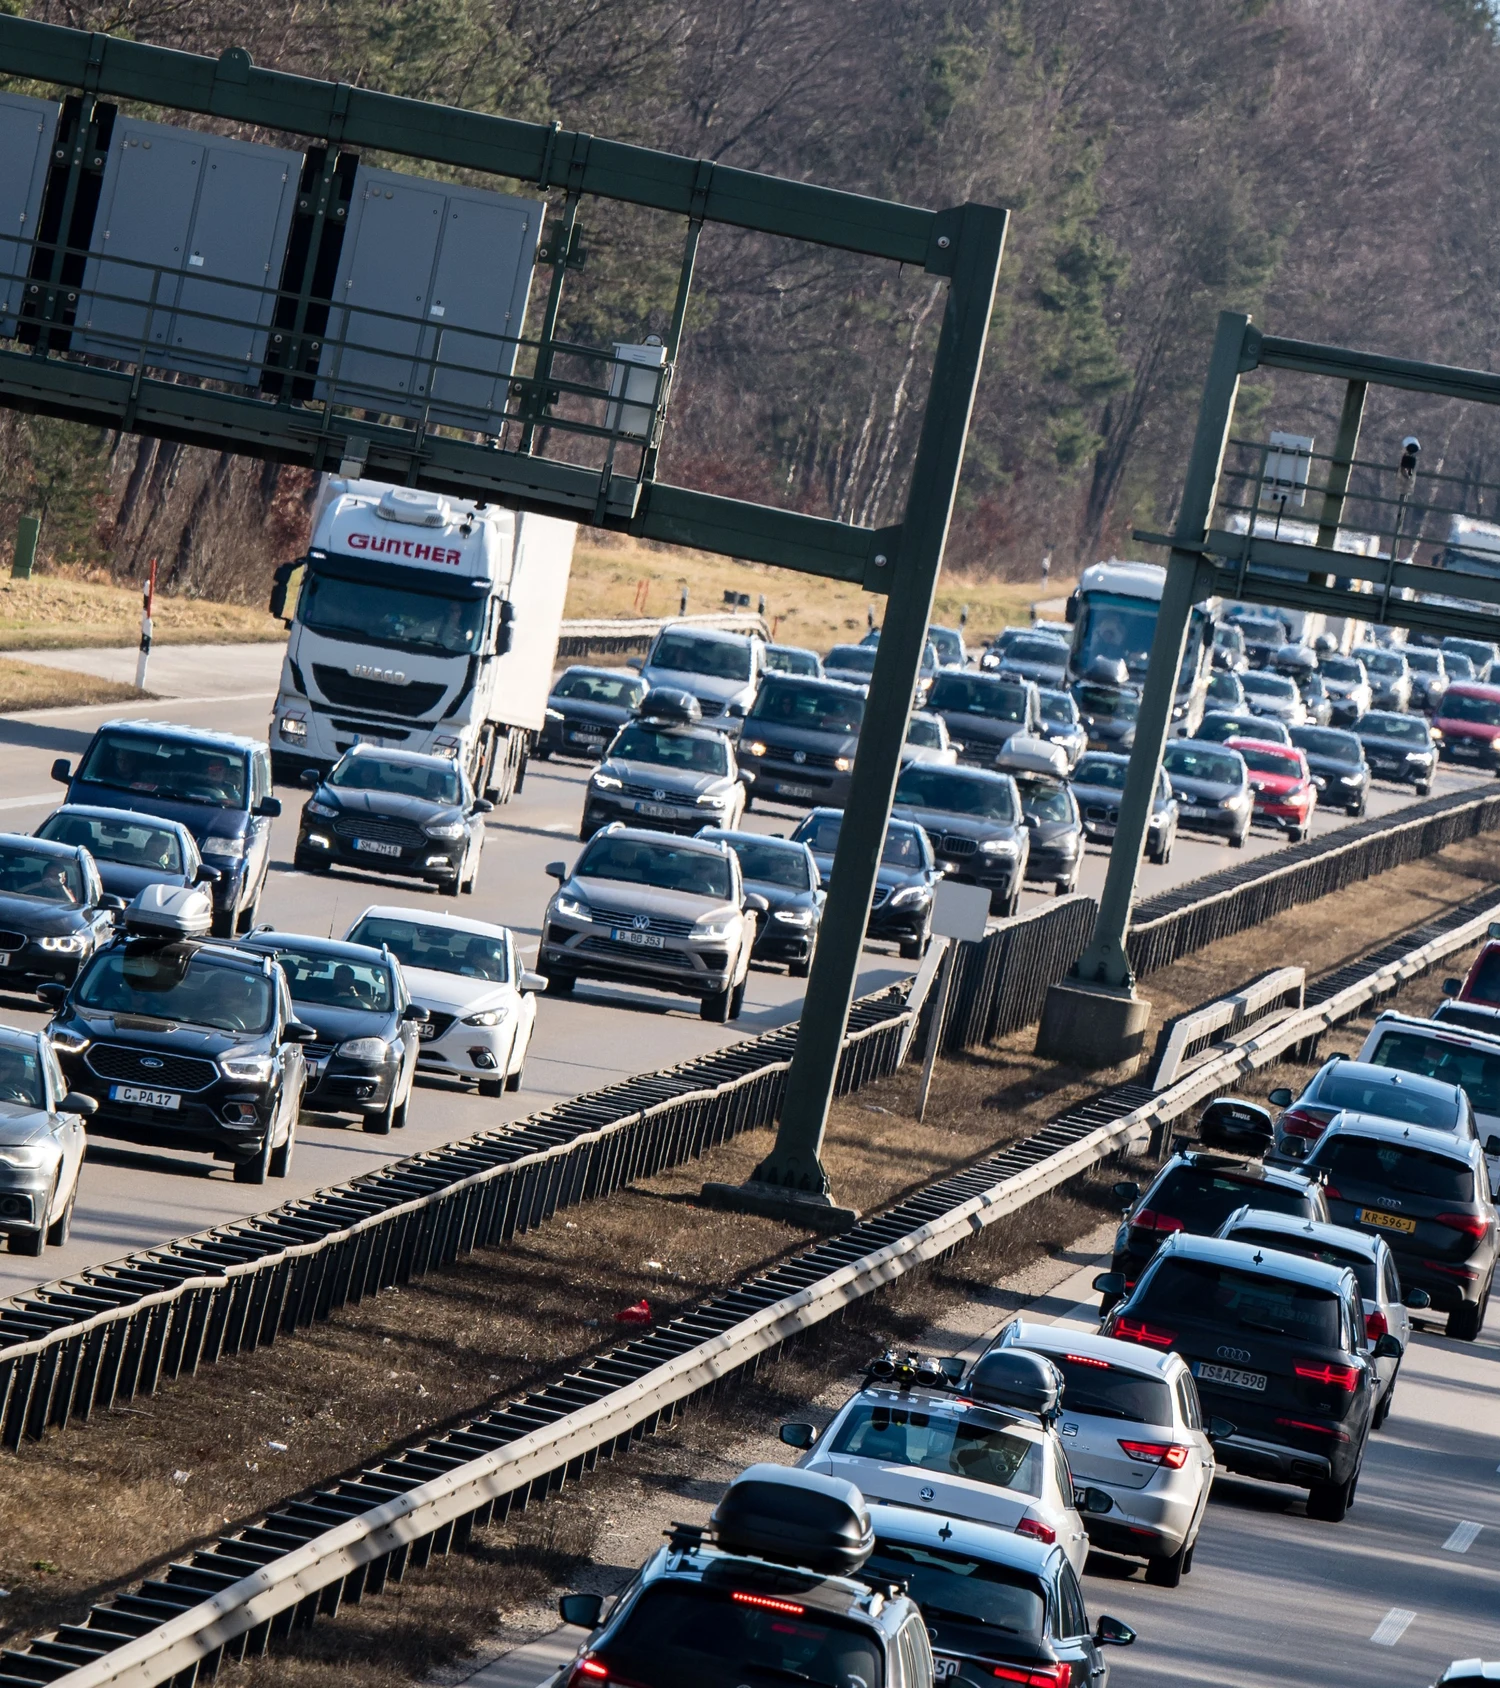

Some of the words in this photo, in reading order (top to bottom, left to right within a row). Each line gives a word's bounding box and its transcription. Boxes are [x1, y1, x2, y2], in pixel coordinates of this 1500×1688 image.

[123, 1088, 132, 1100] C
[138, 1090, 156, 1103] PA
[157, 1093, 172, 1106] 17
[1364, 1211, 1412, 1231] KR-596-J
[1201, 1364, 1216, 1378] TS
[1223, 1371, 1240, 1383] AZ
[1242, 1374, 1265, 1389] 598
